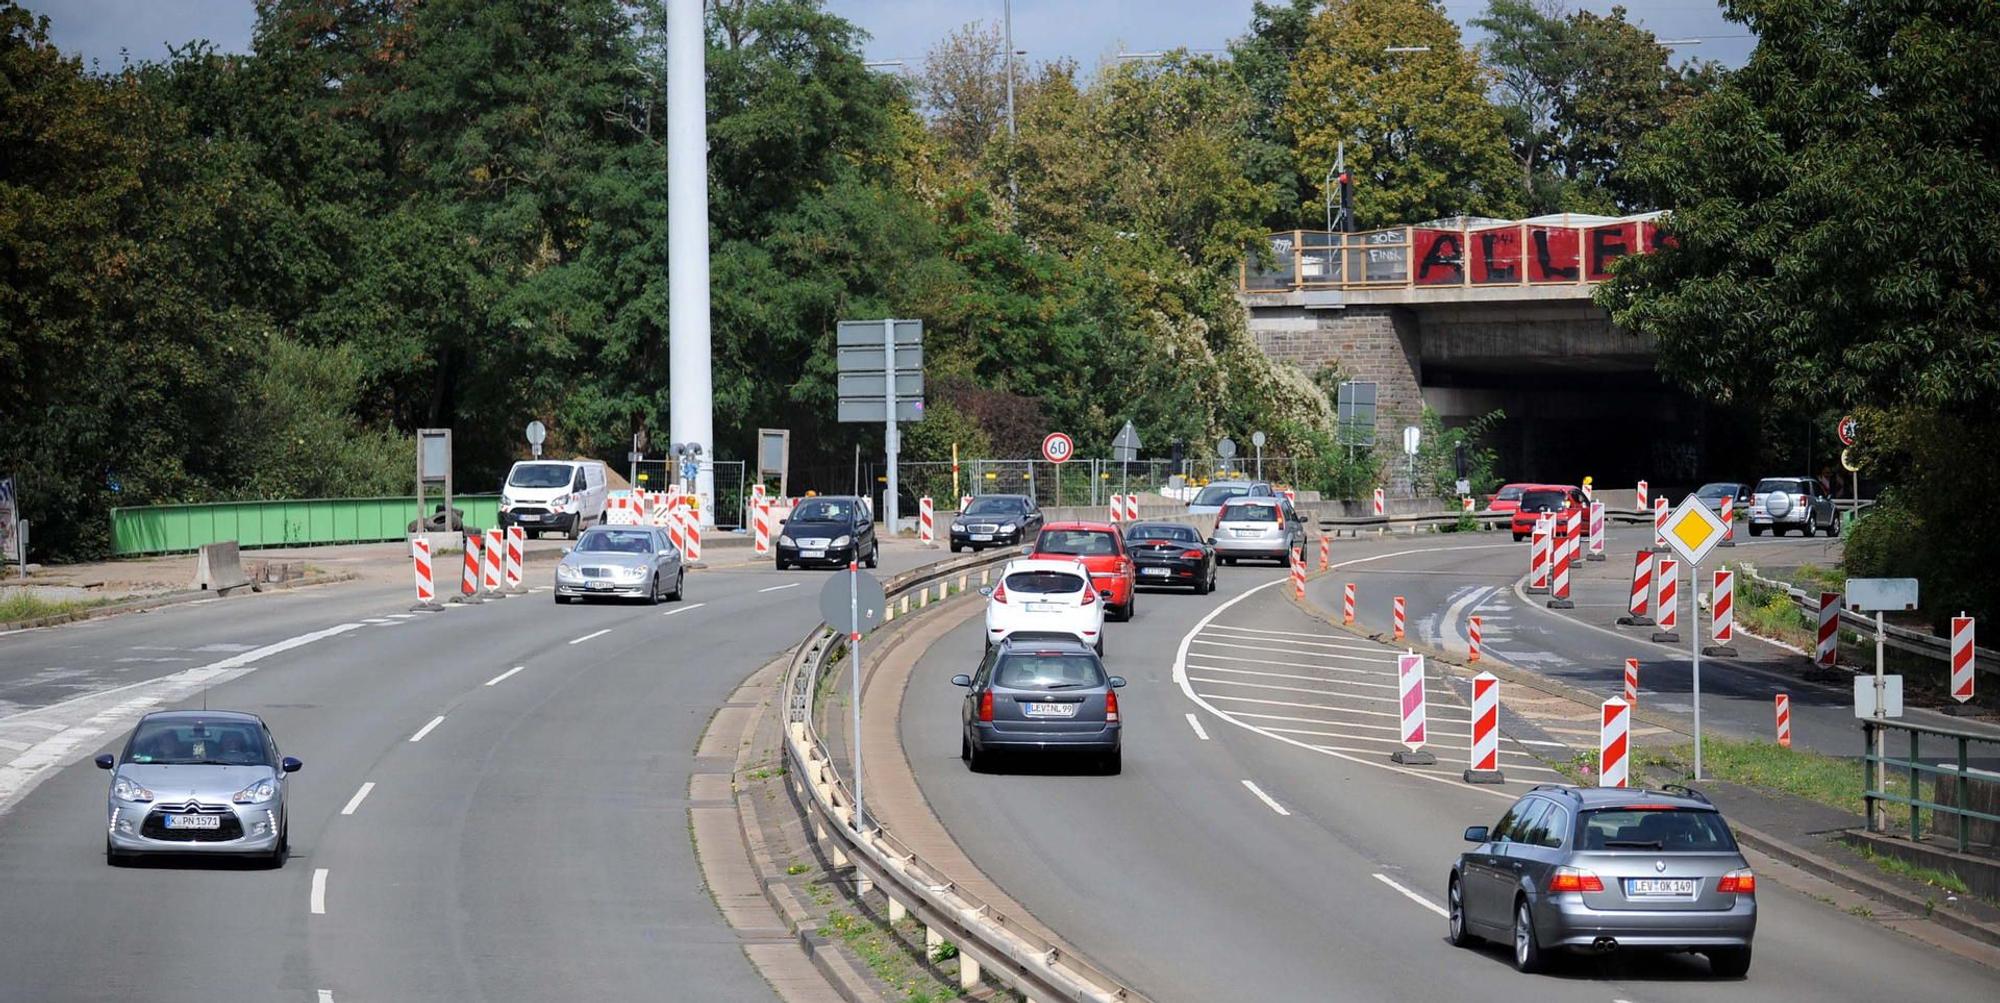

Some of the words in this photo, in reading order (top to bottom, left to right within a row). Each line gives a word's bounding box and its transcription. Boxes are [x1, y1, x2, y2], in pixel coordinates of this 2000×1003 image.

[1050, 441, 1066, 455] 60
[1031, 704, 1046, 712] LEV
[182, 816, 196, 825] PN
[196, 816, 218, 825] 1571
[1635, 881, 1653, 891] LEV
[1675, 881, 1691, 891] 149
